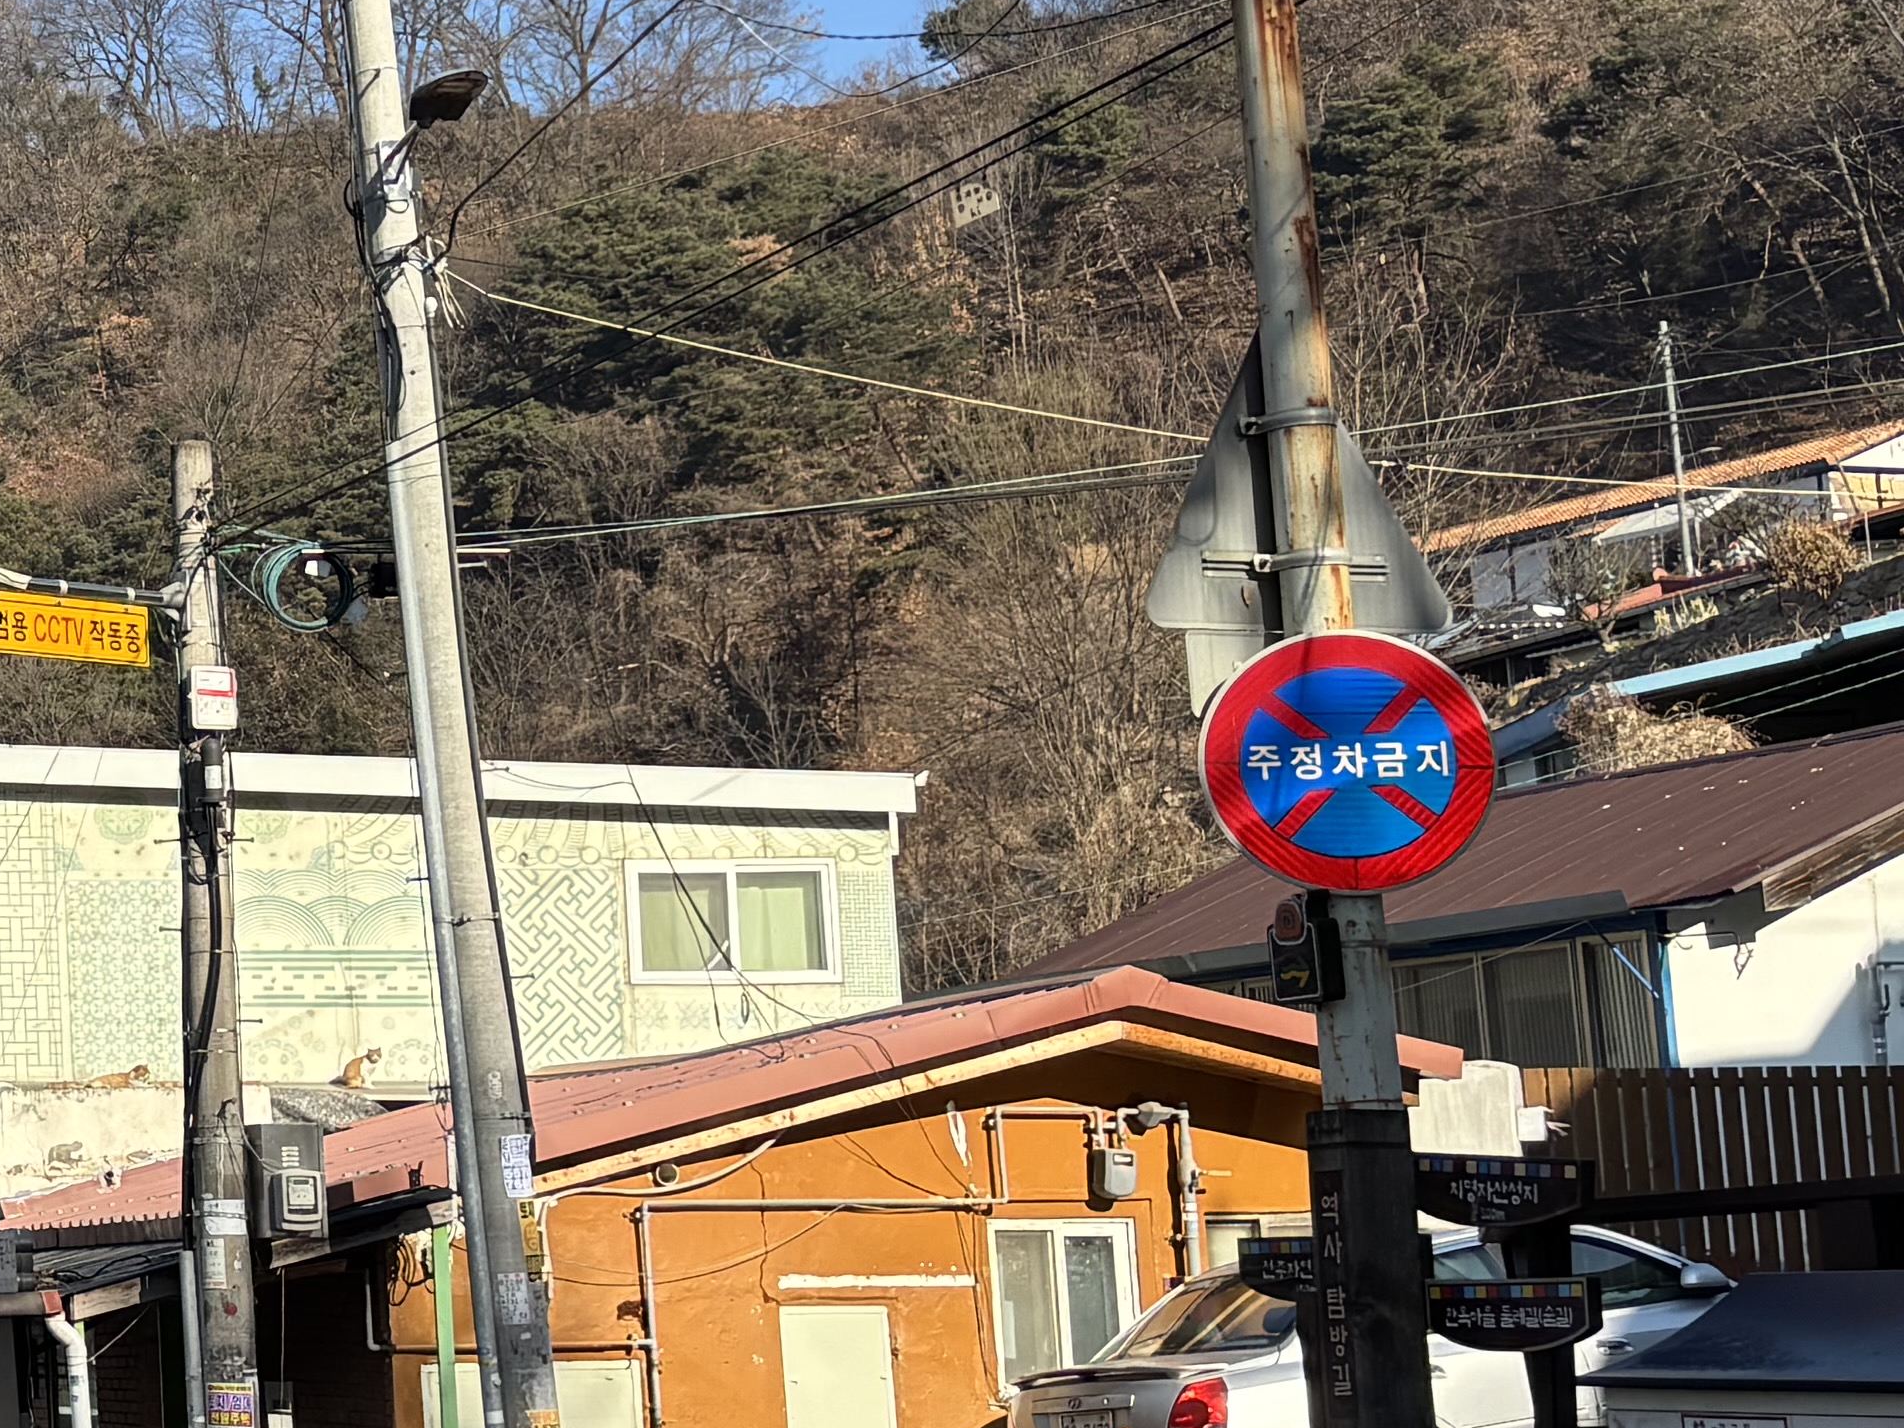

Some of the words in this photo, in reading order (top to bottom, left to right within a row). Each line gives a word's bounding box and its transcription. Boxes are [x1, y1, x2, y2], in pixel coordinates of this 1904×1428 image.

[33, 613, 84, 647] CCTV
[89, 618, 141, 654] 작동중
[1246, 740, 1451, 781] 주정차금지
